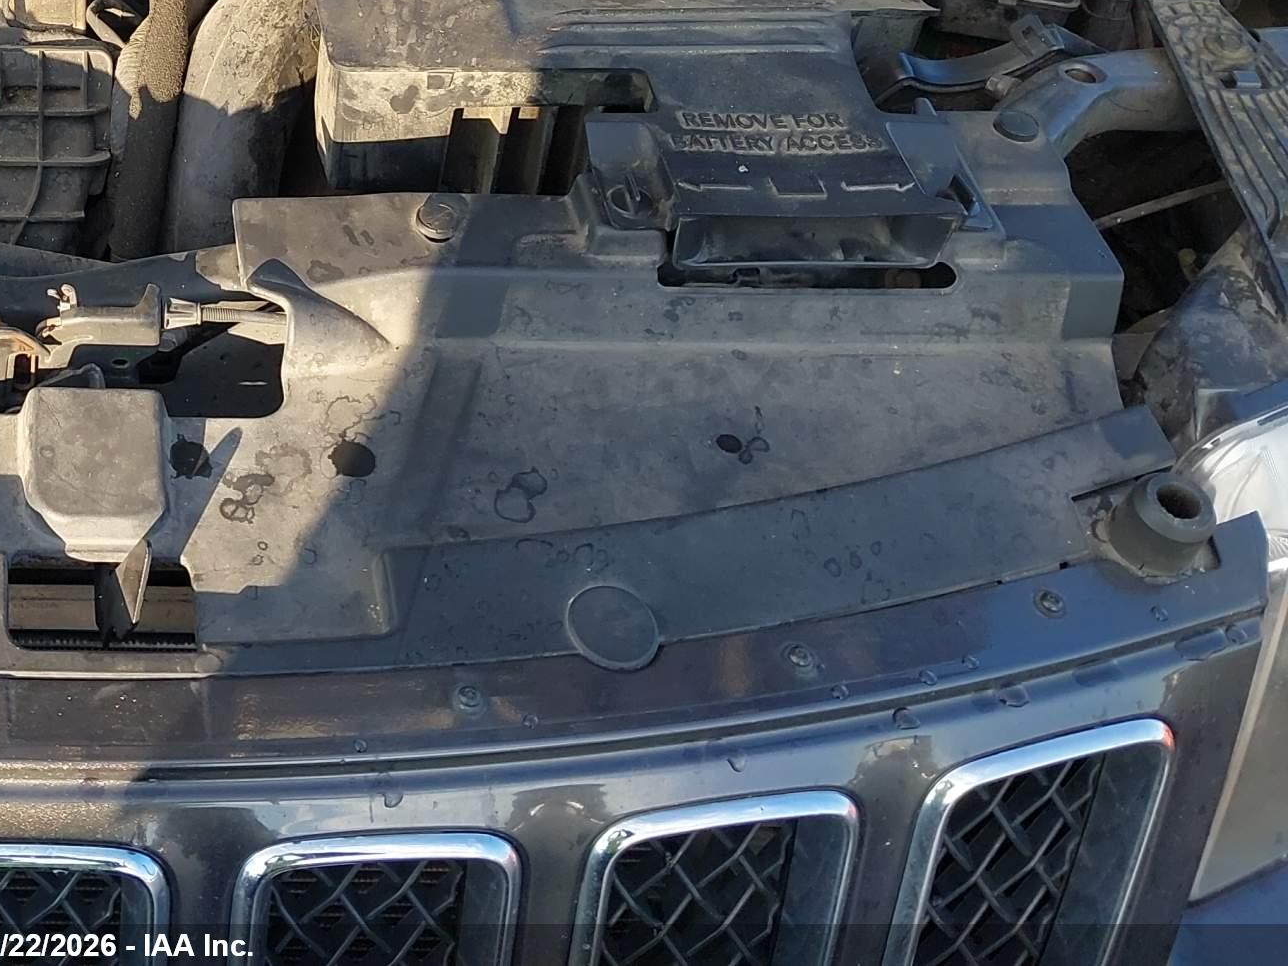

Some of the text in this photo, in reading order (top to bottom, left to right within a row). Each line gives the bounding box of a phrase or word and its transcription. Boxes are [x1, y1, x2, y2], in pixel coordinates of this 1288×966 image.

[681, 112, 844, 129] REMOVE FOR
[669, 133, 883, 151] BATTERY ACCESS
